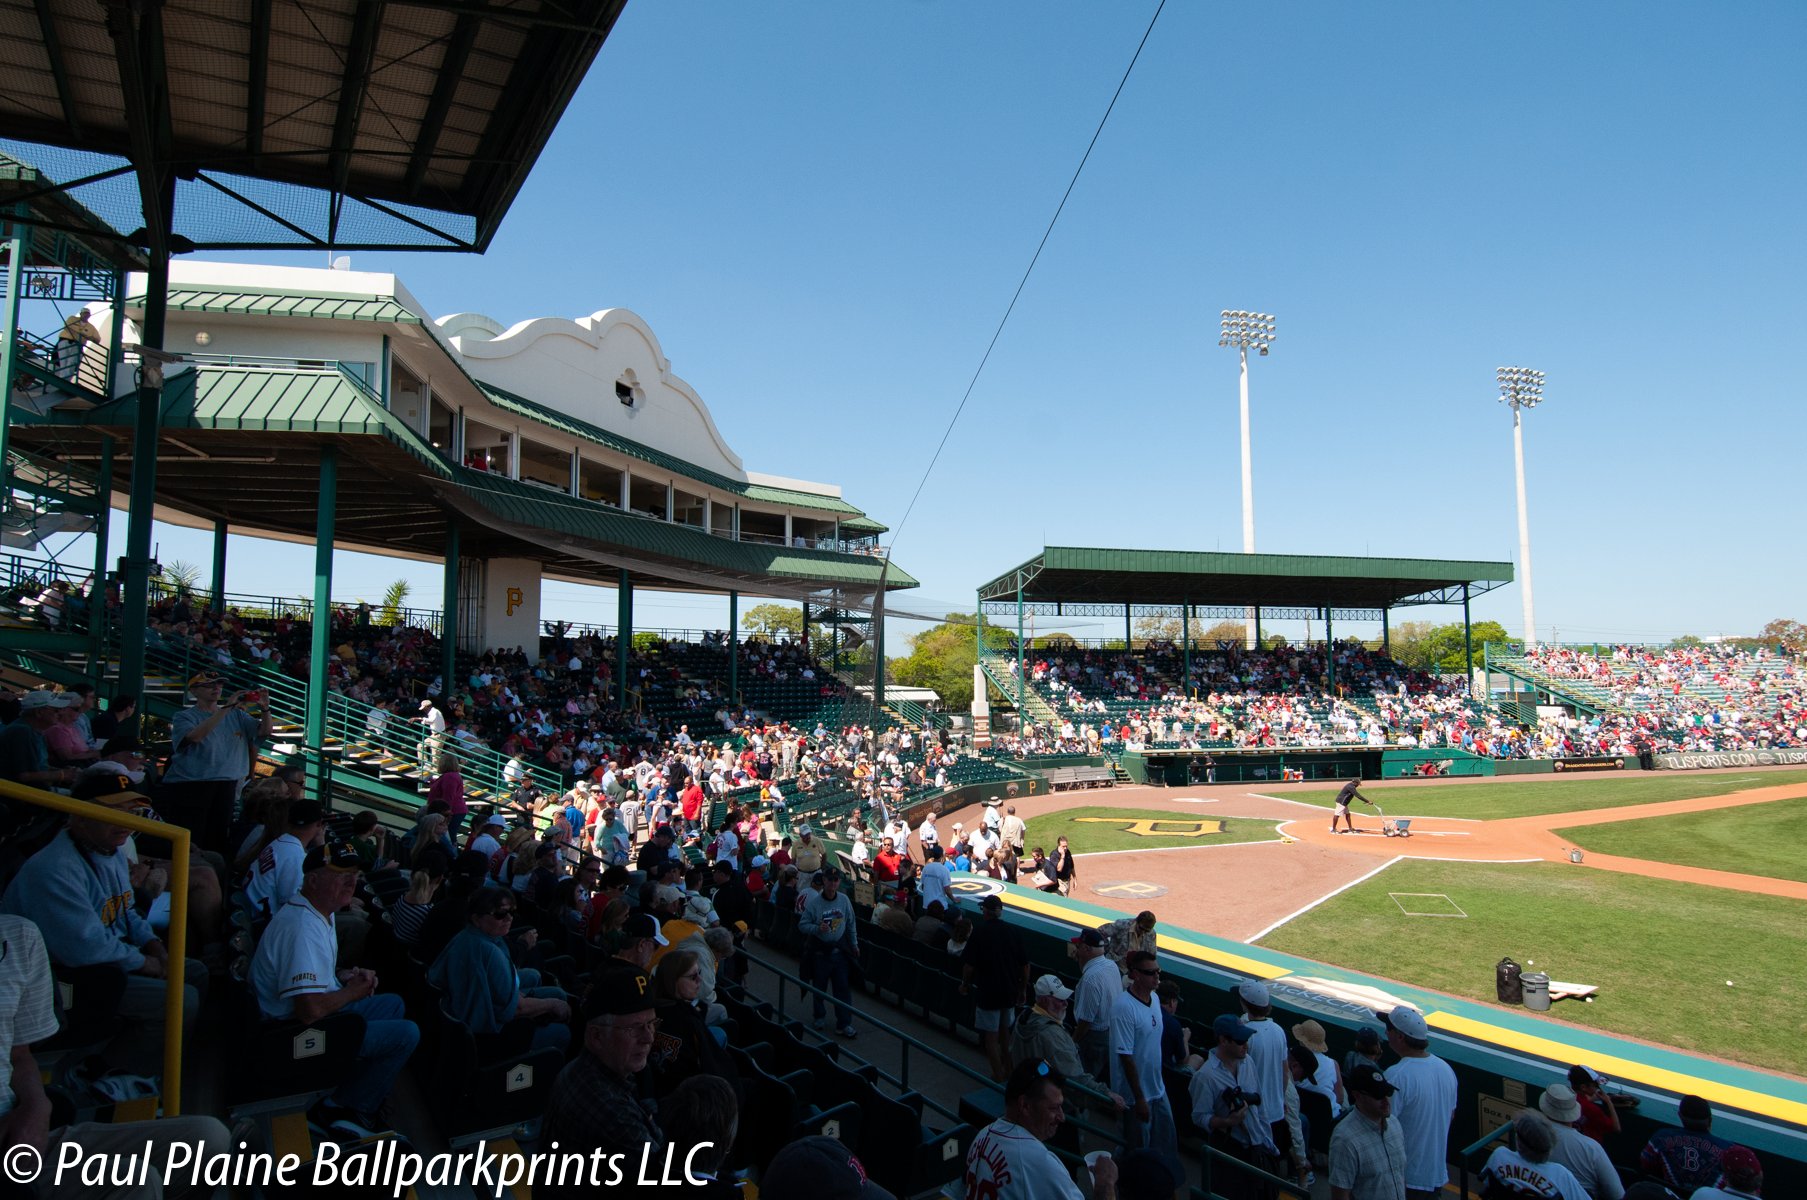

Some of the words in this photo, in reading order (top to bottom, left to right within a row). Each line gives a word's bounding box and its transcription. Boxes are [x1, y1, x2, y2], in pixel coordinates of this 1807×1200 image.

[507, 587, 523, 616] P
[117, 775, 129, 789] P
[1029, 780, 1037, 794] P
[625, 807, 633, 816] 2
[1069, 816, 1231, 838] P
[291, 972, 318, 984] PIRATES
[634, 975, 647, 995] P
[305, 1038, 316, 1050] 5
[515, 1072, 524, 1082] 4
[827, 1127, 834, 1136] 2
[1682, 1146, 1699, 1171] B
[1497, 1165, 1554, 1194] SANCHEZ
